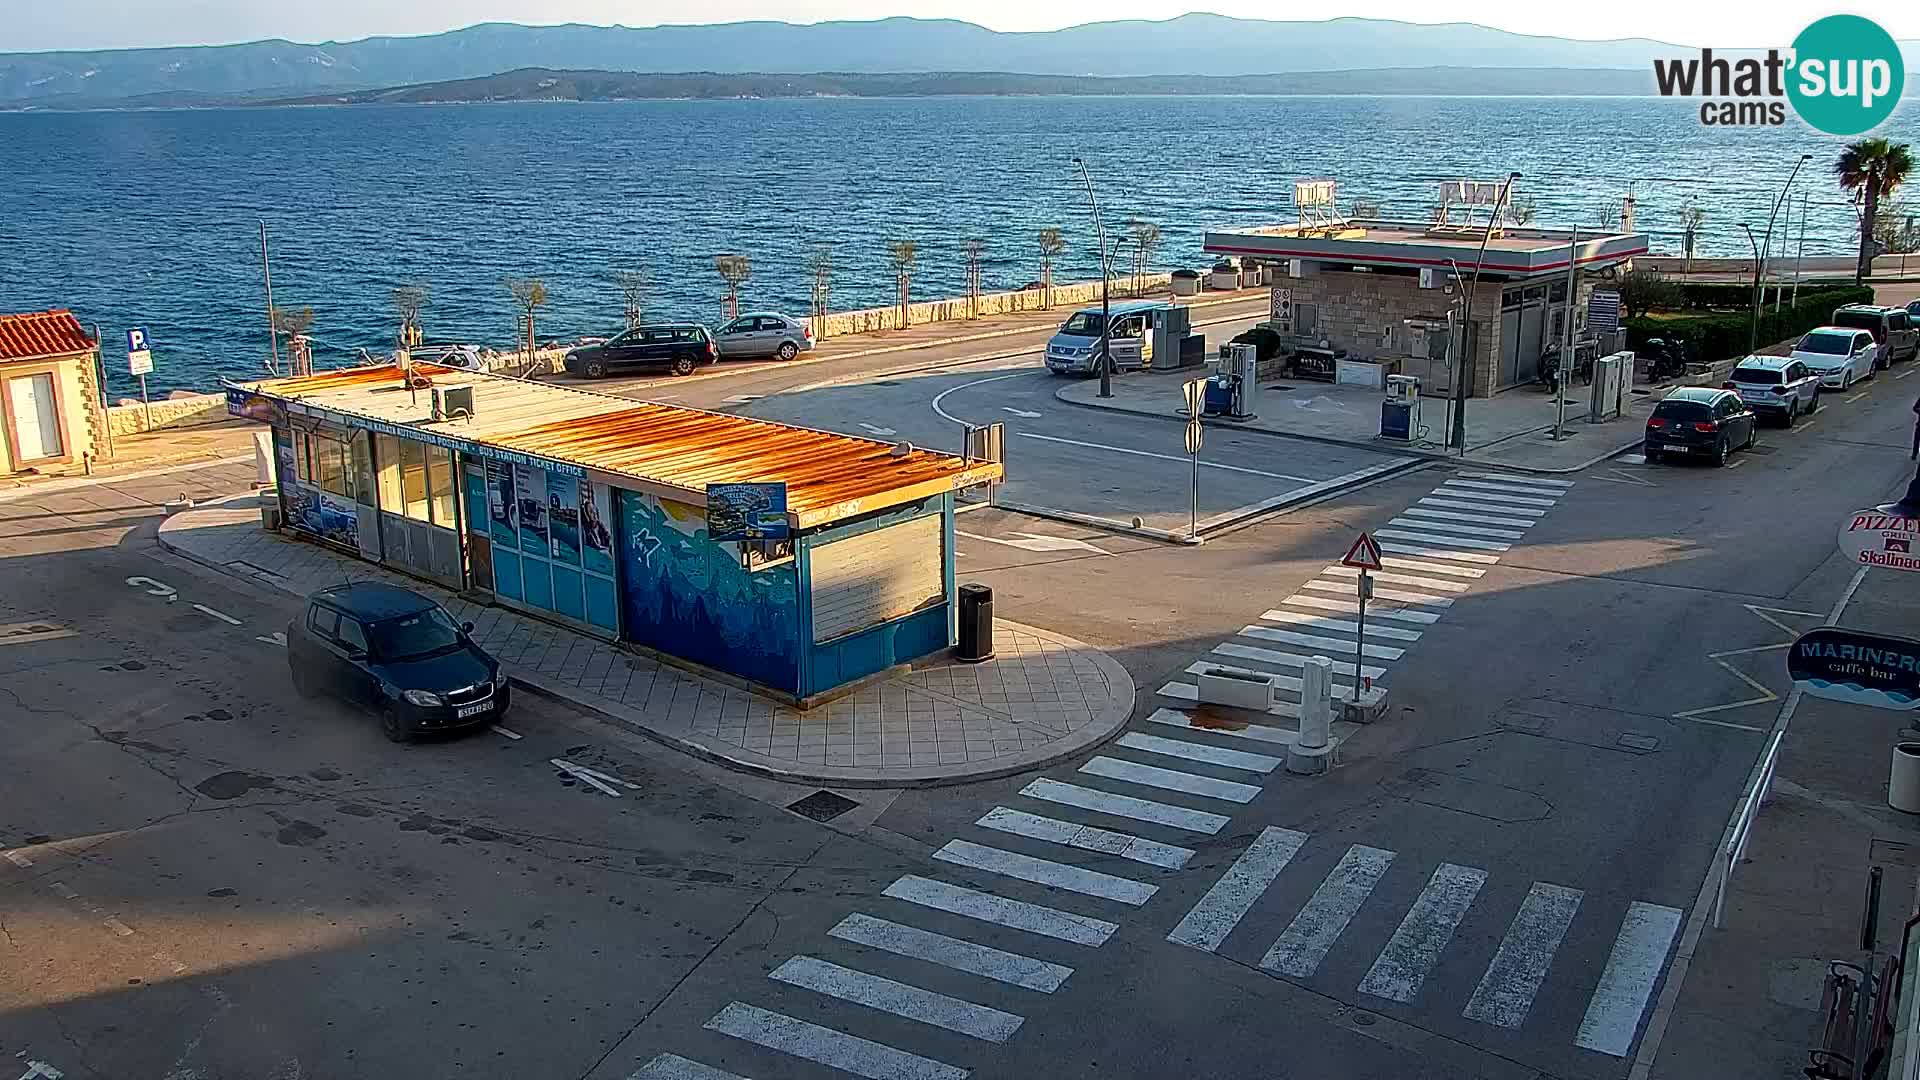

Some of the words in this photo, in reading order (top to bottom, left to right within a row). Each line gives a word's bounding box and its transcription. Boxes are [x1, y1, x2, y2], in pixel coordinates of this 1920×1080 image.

[129, 330, 144, 350] P
[397, 427, 436, 444] AUTOBUSNA
[437, 436, 469, 451] POSTAJA
[479, 446, 494, 457] BUS
[495, 449, 527, 465] STATION
[529, 457, 555, 471] TICKET
[556, 465, 583, 477] OFFICE
[1847, 515, 1920, 535] PIZZE
[1881, 530, 1917, 541] GRILL
[1828, 663, 1865, 676] caffe
[1870, 666, 1897, 680] bar
